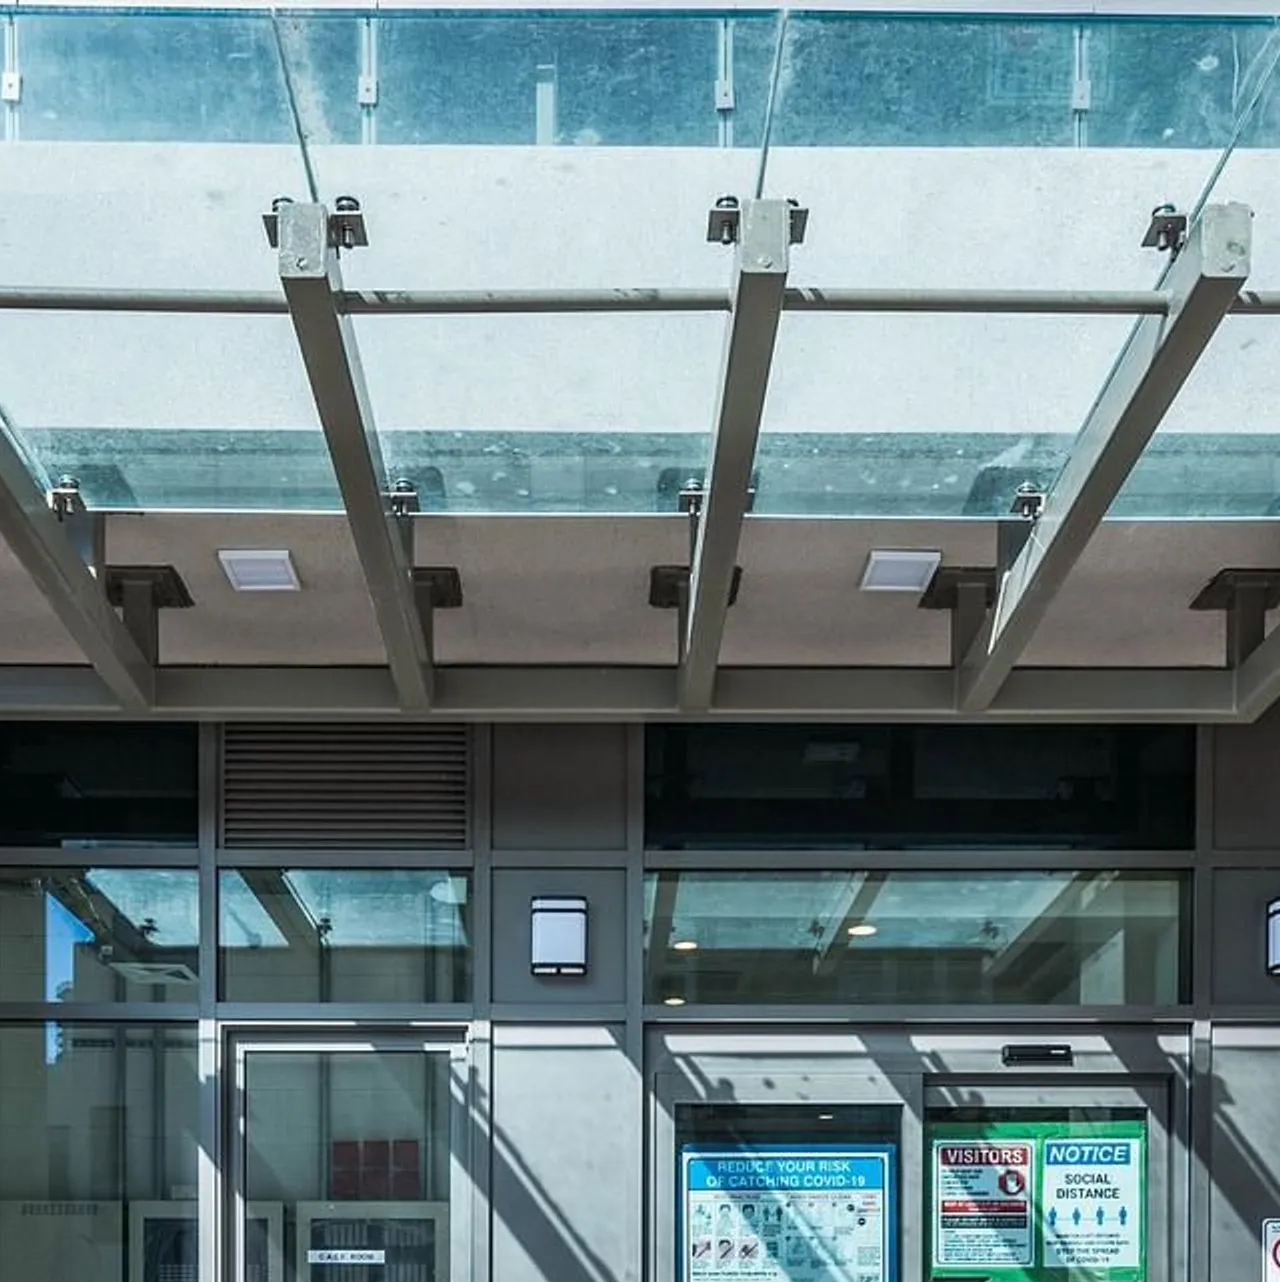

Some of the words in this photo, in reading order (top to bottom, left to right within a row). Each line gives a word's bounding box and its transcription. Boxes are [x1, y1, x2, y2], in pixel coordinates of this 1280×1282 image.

[947, 1149, 1023, 1163] VISITORS
[1049, 1145, 1128, 1163] NOTICE
[717, 1160, 772, 1173] REDUCE
[777, 1160, 815, 1173] YOUR
[819, 1160, 851, 1173] RISK
[706, 1175, 725, 1188] OF
[728, 1175, 800, 1188] CATCHING
[803, 1175, 866, 1188] COVID-19
[1064, 1173, 1112, 1185] SOCIAL
[1056, 1187, 1121, 1200] DISTANCE
